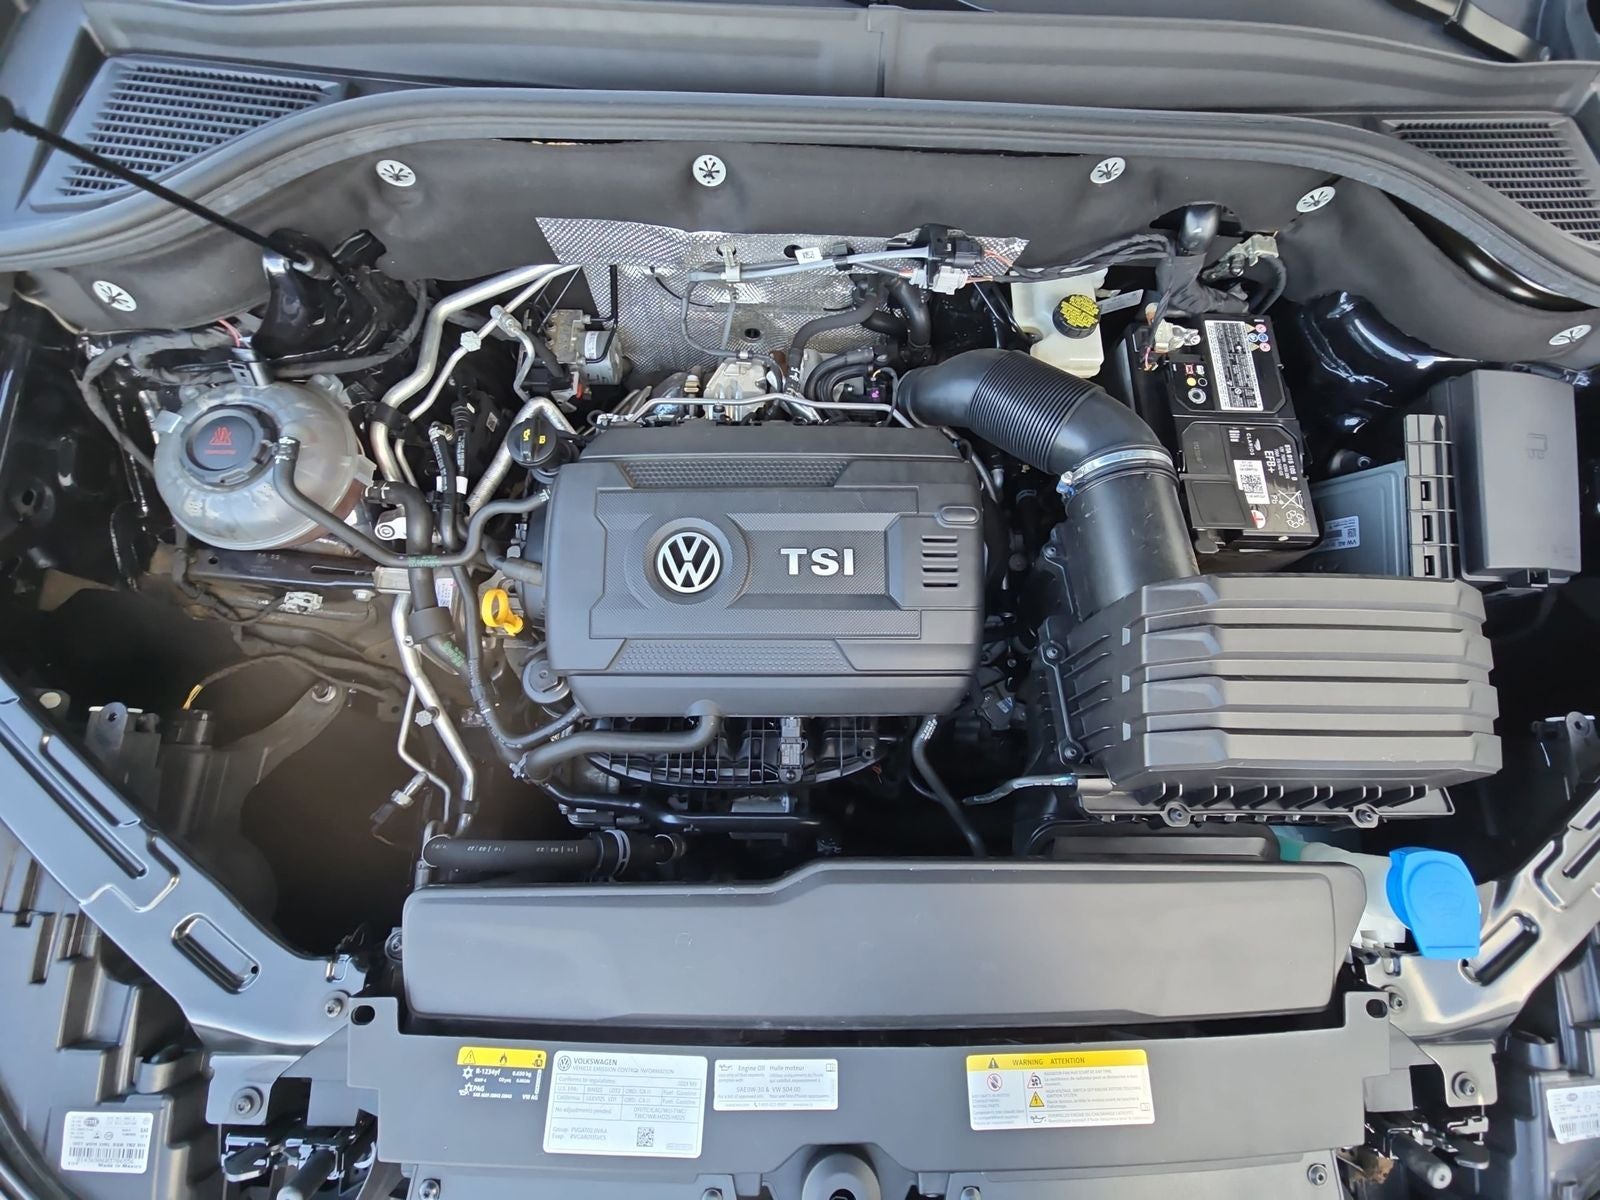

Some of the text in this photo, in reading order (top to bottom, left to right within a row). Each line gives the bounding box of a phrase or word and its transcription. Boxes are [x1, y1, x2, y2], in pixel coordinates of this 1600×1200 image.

[1246, 433, 1255, 456] CLARIOS
[1264, 450, 1277, 473] EFB+
[780, 548, 854, 576] TSI
[573, 1057, 618, 1066] VOLKSWAGEN
[1050, 1057, 1085, 1065] ATTENTION
[475, 1068, 501, 1077] R-1234yf
